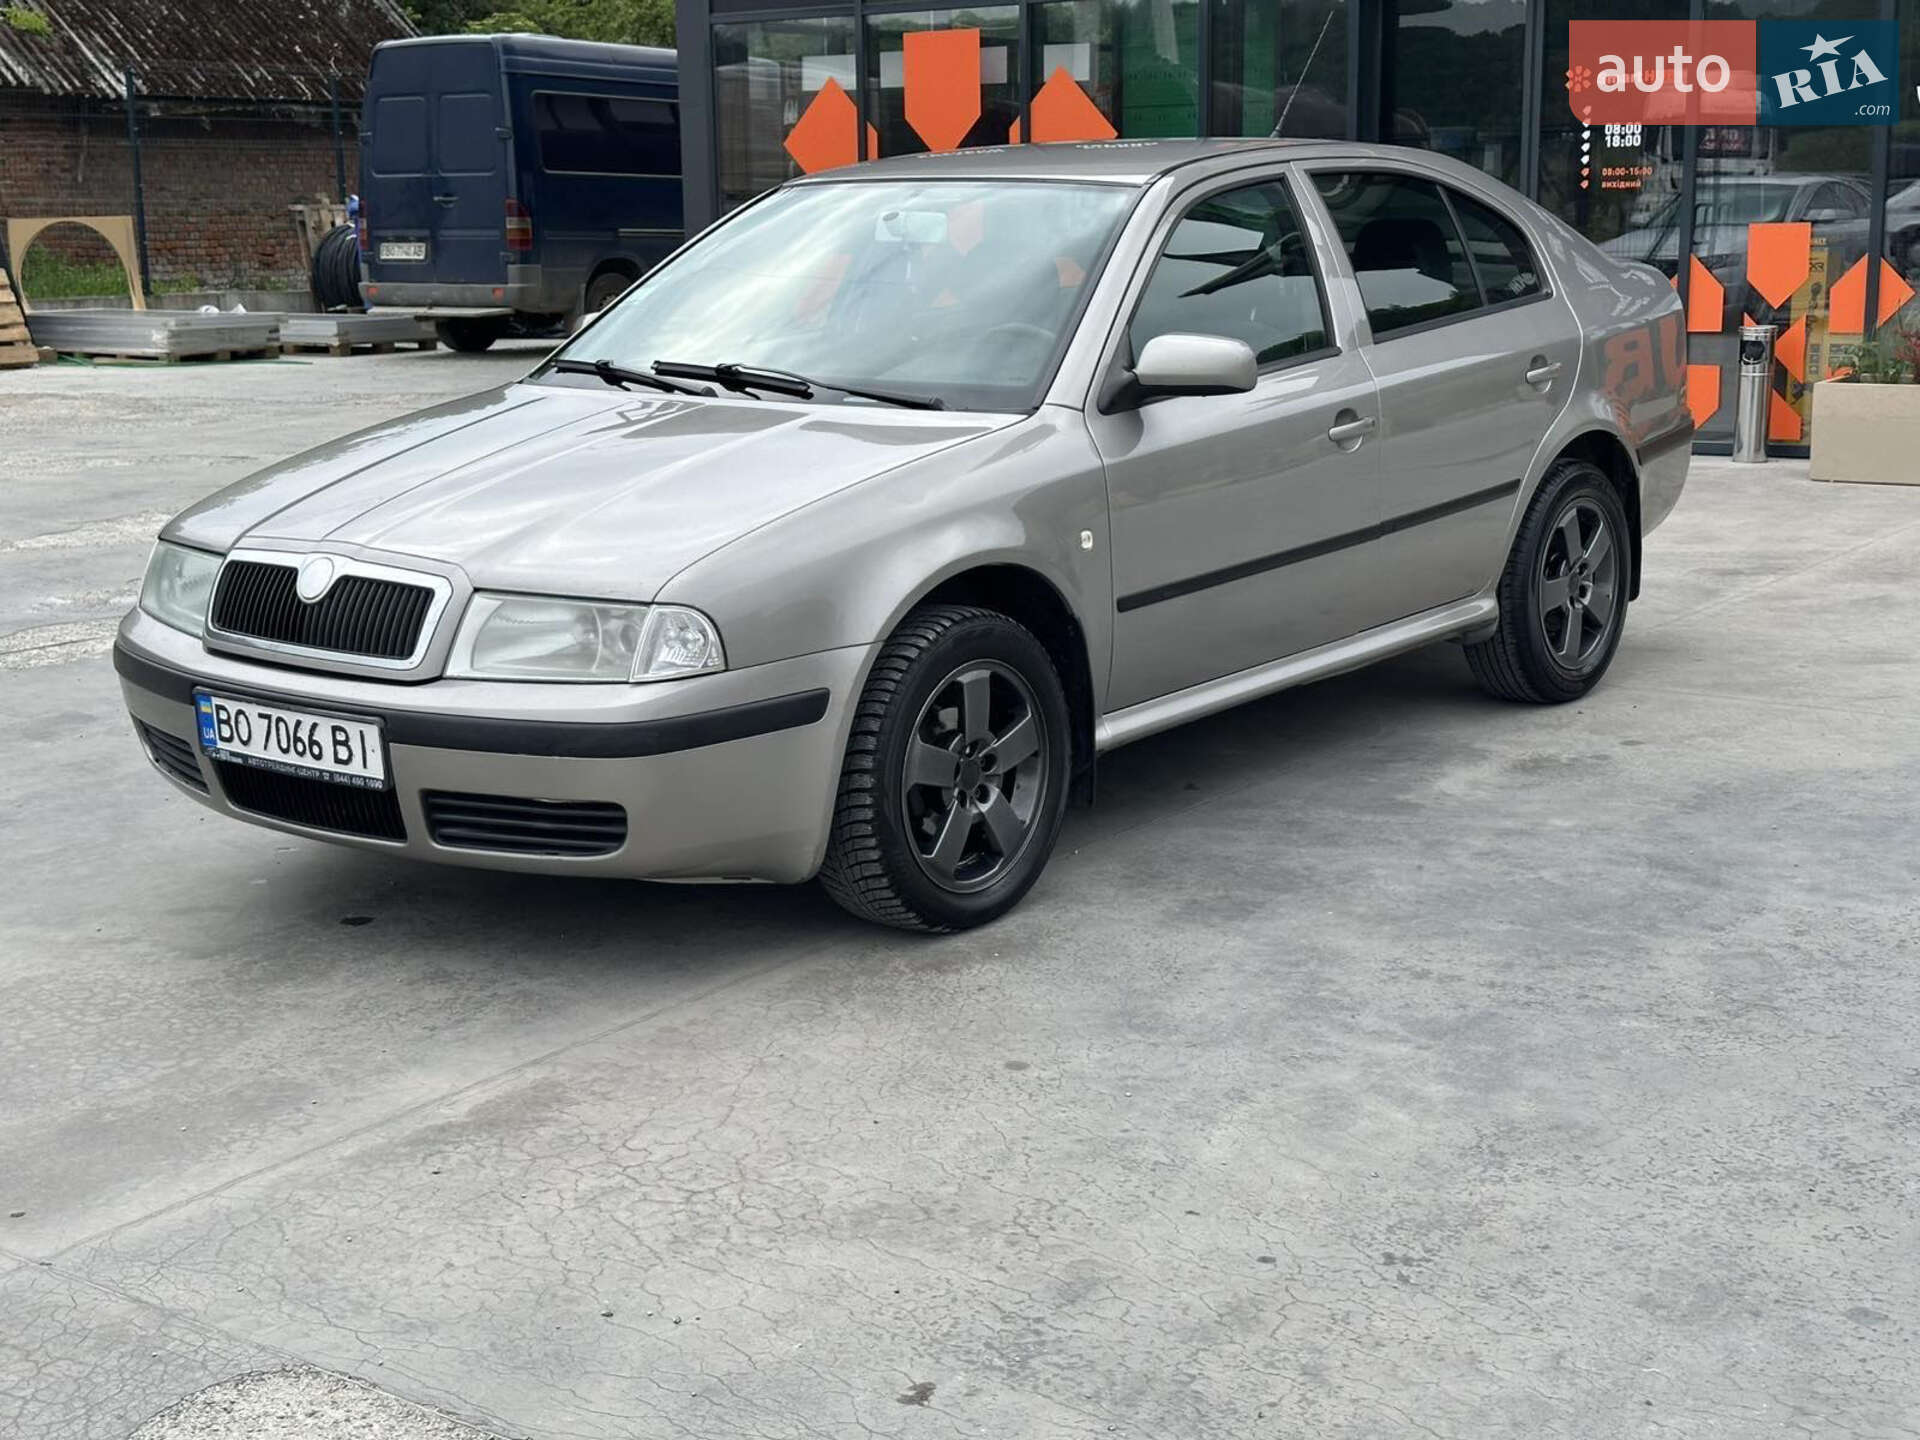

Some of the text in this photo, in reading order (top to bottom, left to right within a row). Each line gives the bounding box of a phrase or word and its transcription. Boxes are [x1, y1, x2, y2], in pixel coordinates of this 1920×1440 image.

[1604, 122, 1642, 135] 08:00
[1604, 135, 1641, 147] 18:00
[203, 727, 216, 740] UA
[215, 703, 368, 769] BO 7066 BI
